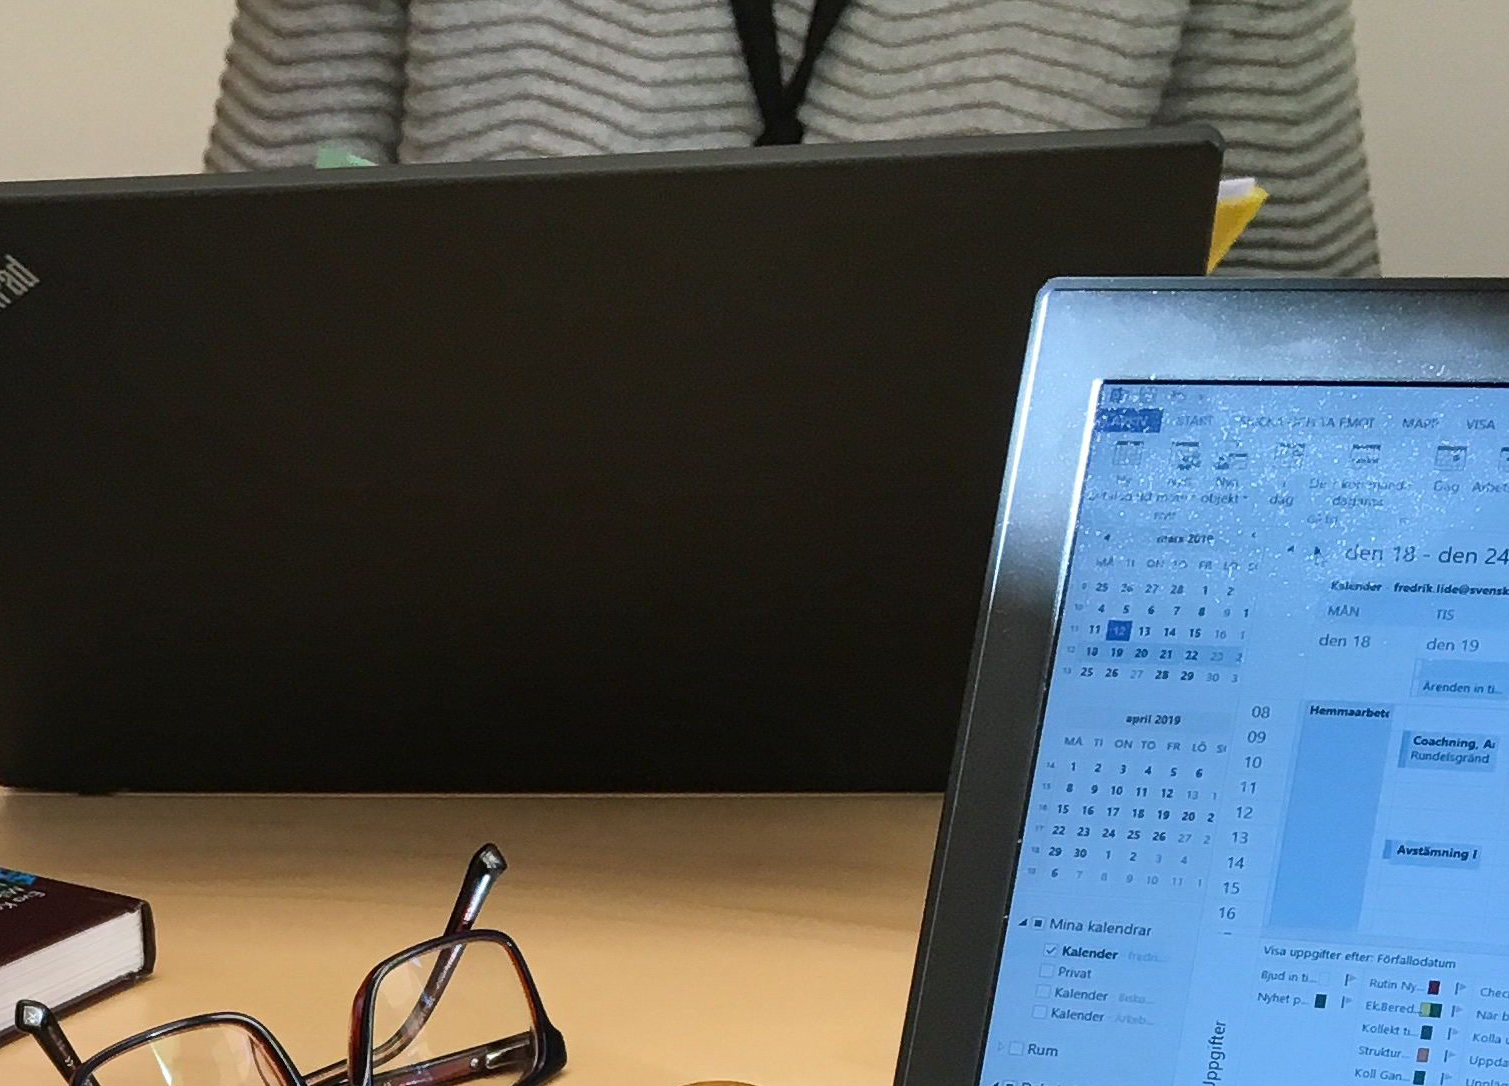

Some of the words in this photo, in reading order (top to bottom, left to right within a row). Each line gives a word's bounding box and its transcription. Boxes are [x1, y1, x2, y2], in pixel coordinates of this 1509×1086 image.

[1466, 420, 1495, 430] VISA
[1345, 544, 1383, 561] den
[1393, 546, 1415, 562] 18
[1439, 547, 1477, 564] den
[1484, 548, 1509, 565] 24
[1331, 581, 1382, 591] Kalender
[1437, 609, 1455, 620] TIS
[1319, 634, 1346, 647] den
[1354, 635, 1371, 648] 18
[1426, 638, 1455, 651] den
[1462, 640, 1479, 652] 19
[1160, 650, 1172, 659] 21
[1081, 668, 1093, 676] 25
[1105, 669, 1118, 678] 26
[1180, 672, 1194, 681] 29
[1206, 673, 1219, 682] 30
[1252, 706, 1270, 719] 08
[1126, 715, 1152, 726] april
[1155, 715, 1182, 725] 2019
[1248, 730, 1266, 744] 09
[1413, 736, 1479, 750] Coachning,
[1094, 738, 1103, 747] TI
[1115, 740, 1133, 749] ON
[1141, 741, 1156, 750] TO
[1167, 742, 1180, 751] FR
[1245, 756, 1261, 769] 10
[1111, 786, 1123, 795] 10
[1161, 789, 1173, 798] 12
[1187, 791, 1198, 800] 13
[1241, 781, 1256, 794] 11
[1058, 804, 1069, 814] 15
[1107, 807, 1119, 817] 17
[1158, 810, 1170, 820] 19
[1182, 812, 1195, 821] 20
[1236, 806, 1253, 819] 12
[1052, 826, 1065, 835] 22
[1102, 829, 1115, 838] 24
[1127, 830, 1140, 840] 25
[1152, 832, 1166, 841] 26
[1232, 831, 1248, 844] 13
[1049, 847, 1062, 856] 29
[1074, 849, 1087, 858] 30
[1397, 845, 1469, 861] Avstämning
[1228, 856, 1244, 869] 14
[1147, 876, 1158, 885] 10
[1223, 882, 1240, 894] 15
[13, 890, 46, 903] Eva
[1219, 907, 1235, 920] 16
[1050, 918, 1083, 931] Mina
[1088, 921, 1152, 937] kalendrar
[1062, 946, 1118, 960] Kalender
[1264, 946, 1286, 956] Visa
[1290, 949, 1341, 961] uppgifter
[1345, 952, 1374, 963] efter:
[1377, 954, 1456, 969] Förfallodatum
[1058, 967, 1091, 979] Privat
[1369, 978, 1397, 990] Rutin
[1054, 987, 1108, 1001] Kalender
[1257, 992, 1289, 1004] Nyhet
[1051, 1008, 1104, 1022] Kalender
[1362, 1023, 1399, 1036] Kollekt
[1473, 1033, 1501, 1044] Kolla
[1028, 1043, 1058, 1057] Rum
[1355, 1068, 1375, 1079] Koll
